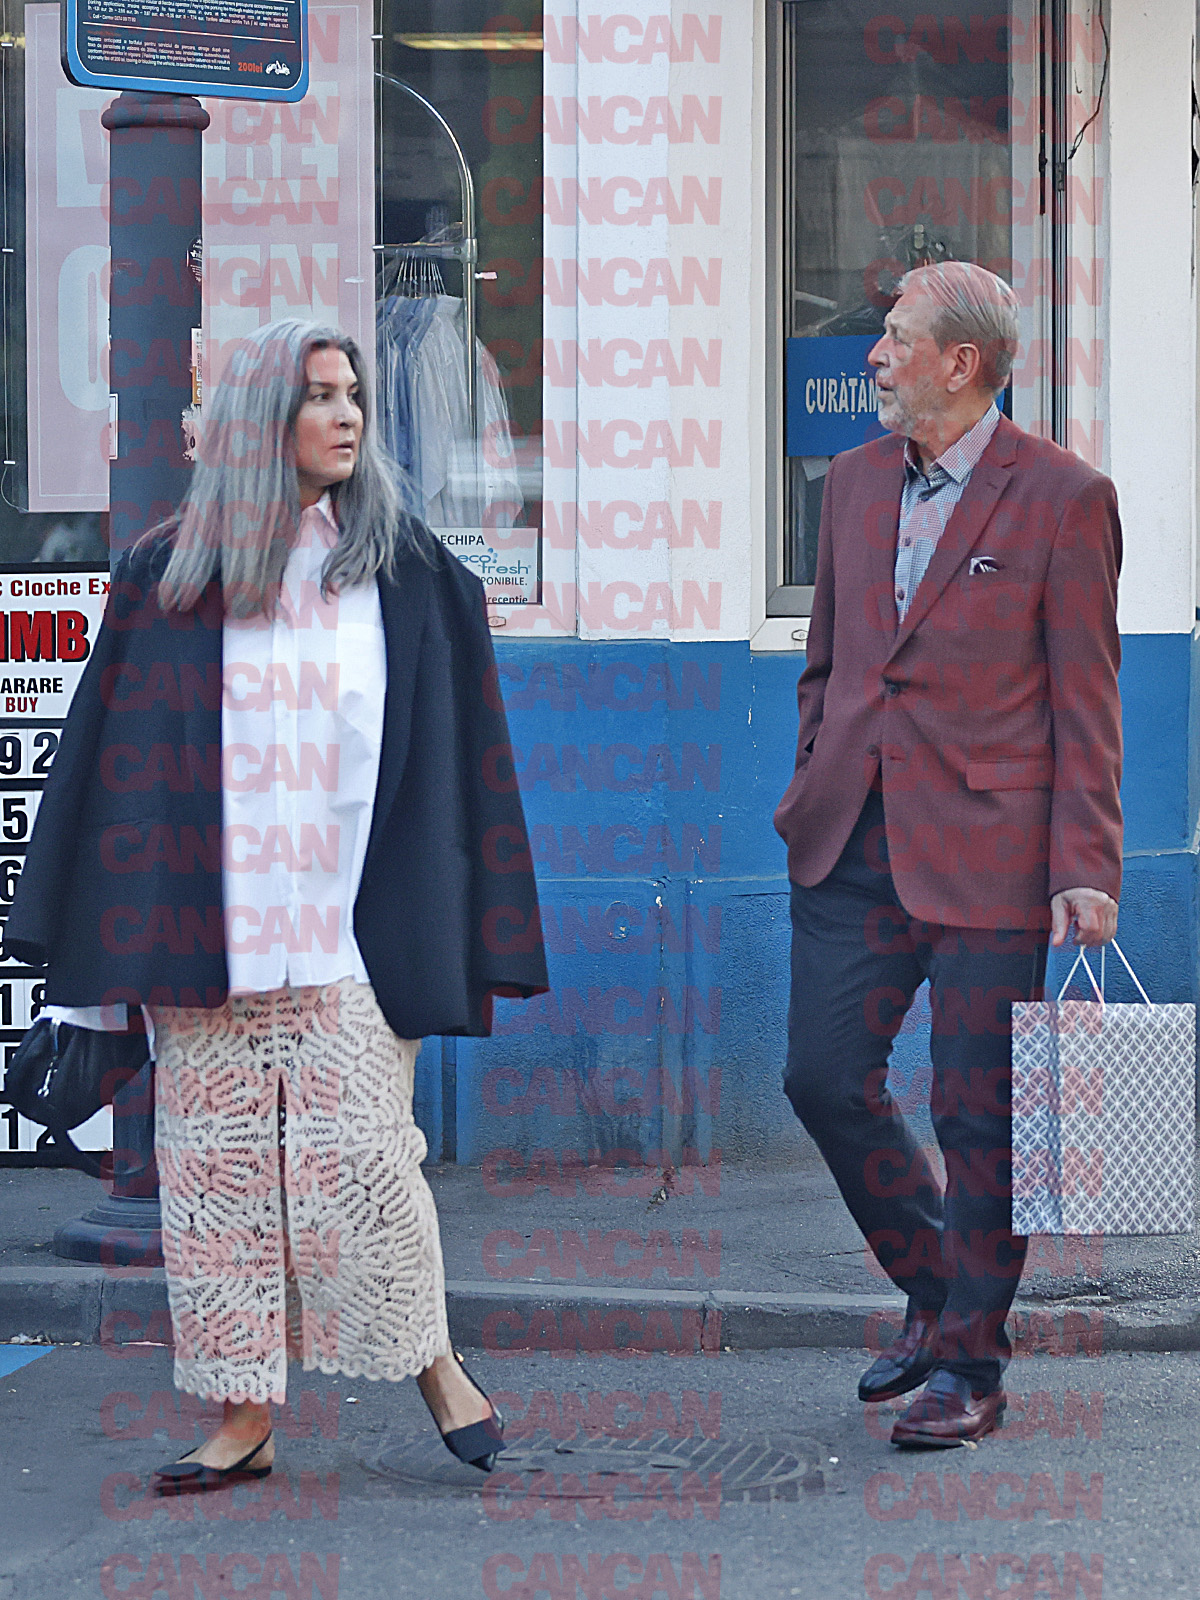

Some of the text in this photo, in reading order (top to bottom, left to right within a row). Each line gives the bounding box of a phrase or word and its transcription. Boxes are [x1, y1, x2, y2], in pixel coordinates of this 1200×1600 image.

[441, 535, 485, 546] ECHIPA
[478, 560, 529, 574] fresh
[10, 578, 81, 597] Cloche
[0, 677, 63, 694] ARARE
[5, 697, 38, 713] BUY
